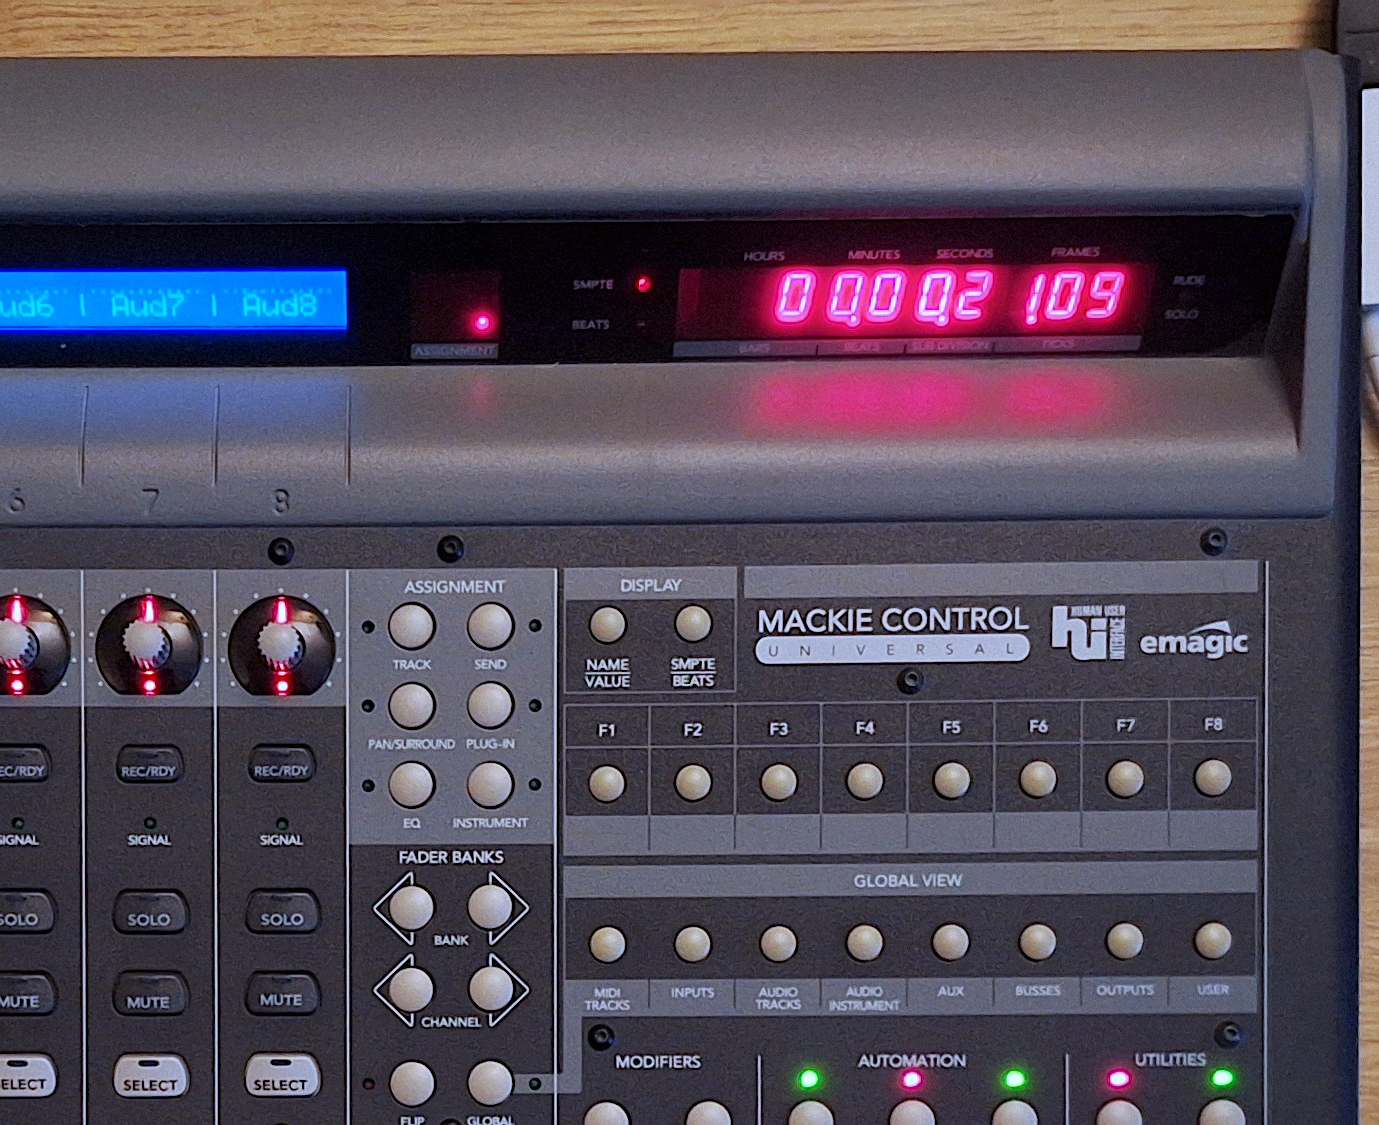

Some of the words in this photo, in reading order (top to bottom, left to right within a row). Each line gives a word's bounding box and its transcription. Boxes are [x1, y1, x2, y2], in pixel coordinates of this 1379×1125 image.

[744, 250, 785, 261] HOURS
[848, 249, 901, 260] MINUTES
[935, 248, 994, 259] SECONDS
[1051, 246, 1101, 257] FRAMES
[572, 279, 614, 290] SMPTE
[572, 319, 610, 331] BEATS
[404, 581, 506, 593] ASSIGNMENT
[620, 579, 682, 592] DISPLAY
[758, 608, 873, 633] MACKIE
[882, 606, 1030, 632] CONTROL
[1140, 621, 1248, 659] emagic
[768, 641, 1015, 658] UNIVERSAL
[393, 659, 432, 669] TRACK
[474, 659, 507, 669] SEND
[586, 659, 629, 671] NAME
[671, 658, 715, 670] SMPTE
[584, 675, 631, 688] VALUE
[672, 675, 715, 687] BEATS
[598, 724, 616, 737] F1
[683, 723, 703, 737] F2
[769, 722, 789, 736] F3
[855, 721, 875, 735] F4
[942, 721, 961, 734] F5
[1029, 720, 1049, 733] F6
[1116, 719, 1136, 732] F7
[1204, 718, 1223, 731] F8
[368, 739, 456, 750] PAN/SURROUND
[466, 738, 515, 749] PLUG-IN
[121, 765, 176, 777] REC/RDY
[253, 765, 308, 777] REC/RDY
[403, 818, 421, 829] EQ
[453, 817, 529, 828] INSTRUMENT
[127, 834, 172, 847] SIGNAL
[259, 834, 304, 847] SIGNAL
[399, 851, 448, 864] FADER
[452, 851, 504, 863] BANKS
[854, 874, 919, 888] GLOBAL
[922, 874, 963, 887] VIEW
[128, 913, 171, 926] SOLO
[260, 913, 304, 926] SOLO
[434, 935, 469, 947] BANK
[594, 988, 621, 998] MIDI
[671, 988, 715, 998] INPUTS
[759, 987, 798, 998] AUDIO
[846, 986, 883, 997] AUDIO
[937, 986, 964, 997] AUX
[1015, 985, 1061, 996] BUSSES
[1097, 984, 1154, 996] OUTPUTS
[1197, 984, 1229, 995] USER
[127, 996, 170, 1008] MUTE
[259, 994, 303, 1006] MUTE
[584, 1000, 630, 1011] TRACKS
[756, 999, 802, 1010] TRACKS
[829, 1000, 900, 1011] INSTRUMENT
[421, 1017, 482, 1028] CHANNEL
[615, 1056, 702, 1069] MODIFIERS
[857, 1054, 966, 1068] AUTOMATION
[1135, 1053, 1206, 1067] UTILITIES
[123, 1079, 178, 1091] SELECT
[253, 1079, 308, 1091] SELECT
